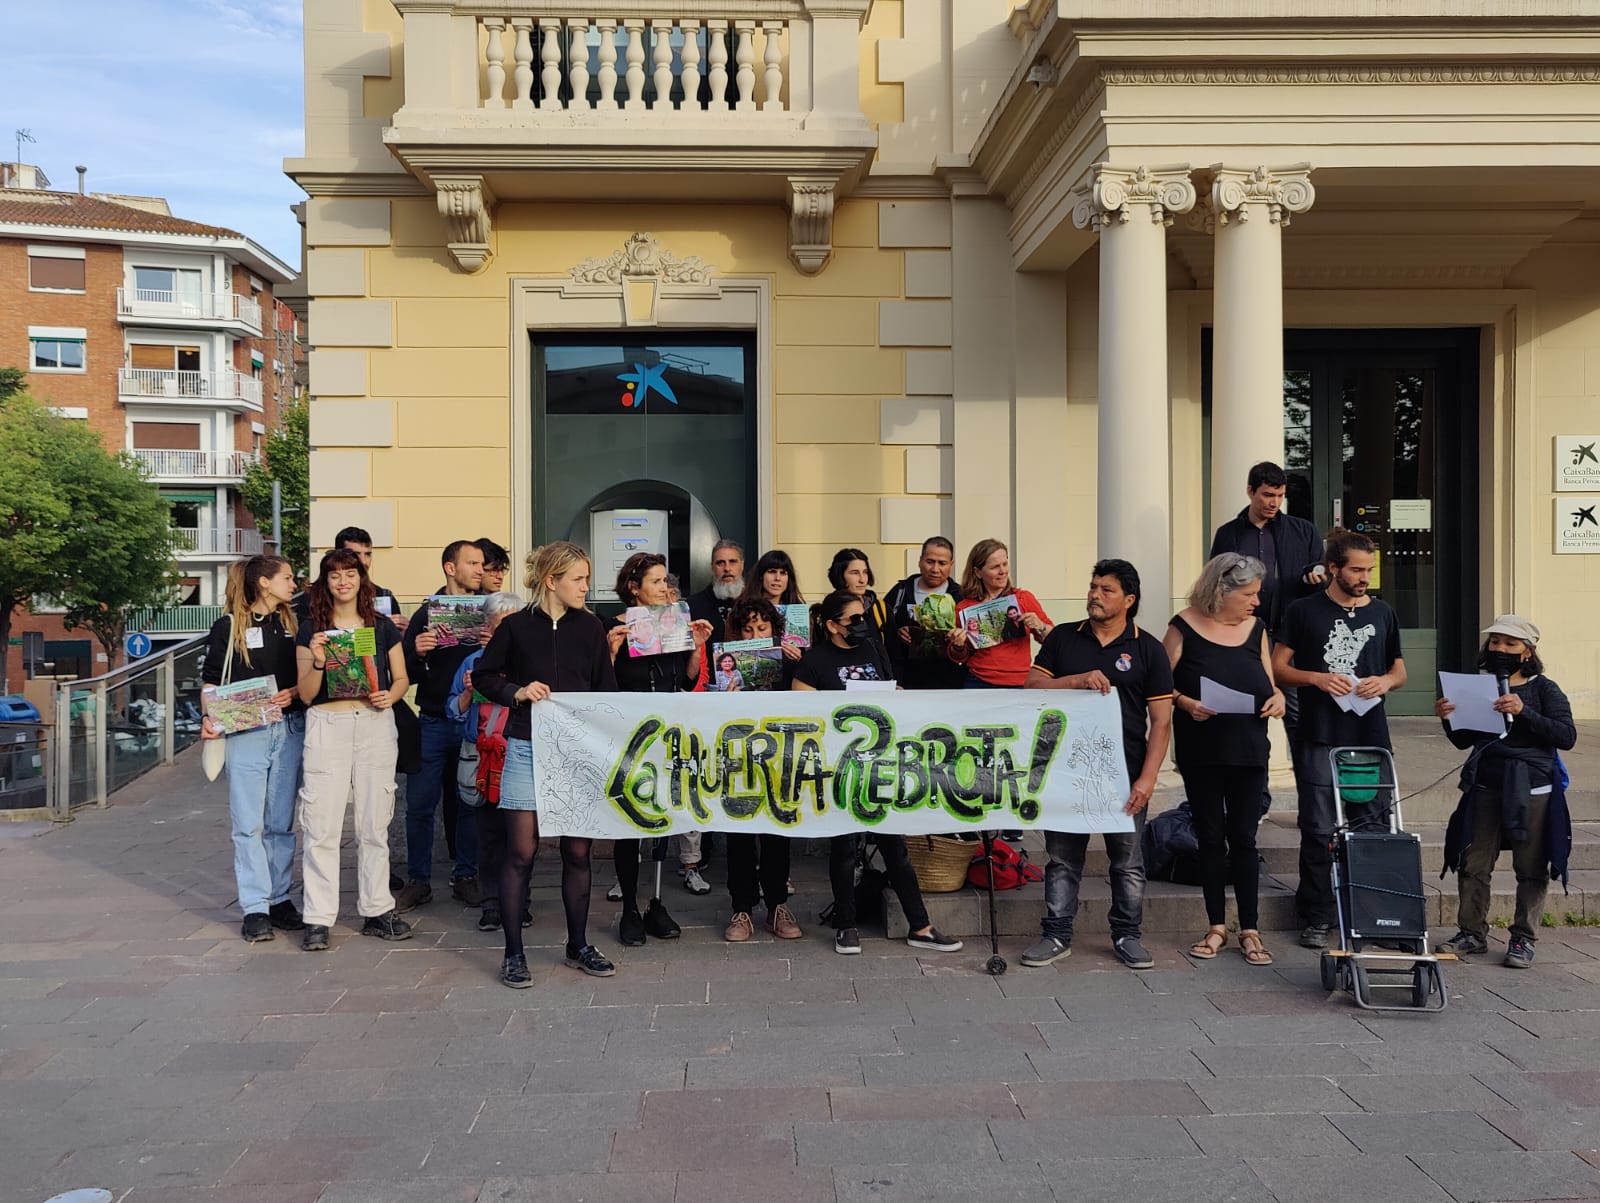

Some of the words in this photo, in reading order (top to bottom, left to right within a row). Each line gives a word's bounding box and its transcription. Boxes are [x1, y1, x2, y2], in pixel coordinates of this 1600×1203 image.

[1563, 466, 1600, 476] CaixaBan
[1563, 529, 1600, 538] CaixaBan
[664, 718, 832, 827] HUERTA
